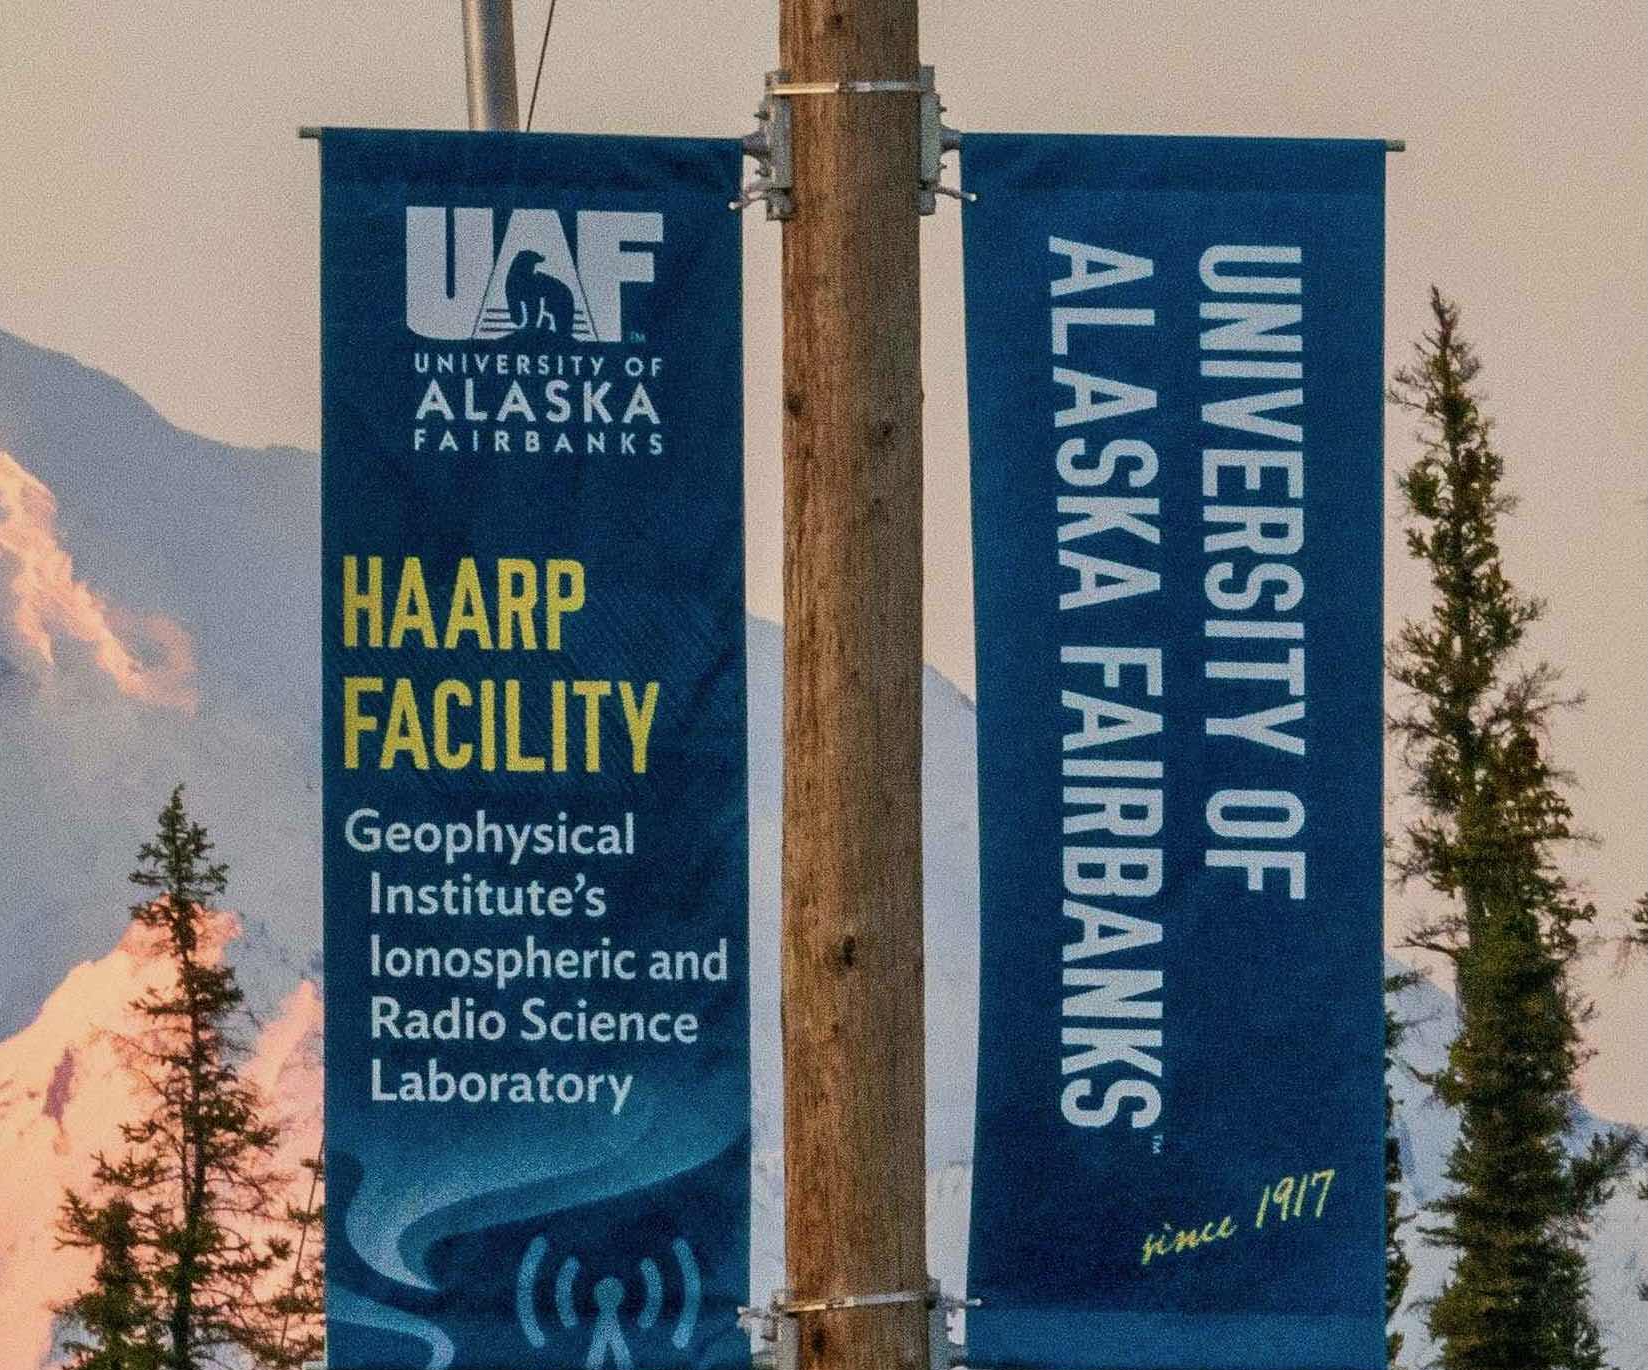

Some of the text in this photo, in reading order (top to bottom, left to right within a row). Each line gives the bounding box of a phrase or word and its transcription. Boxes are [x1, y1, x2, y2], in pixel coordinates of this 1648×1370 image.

[406, 206, 663, 342] UAF
[415, 353, 661, 377] UNIVERSITY OF
[417, 379, 659, 424] ALASKA
[414, 429, 662, 454] FAIRBANKS
[1199, 246, 1305, 899] UNIVERSITY OF
[344, 557, 585, 649] HAARP
[1049, 237, 1163, 1128] ALASKA FAIRBANKS
[345, 678, 659, 772] FACILITY
[346, 808, 633, 864] Geophysical
[371, 935, 727, 988] Ionospheric and
[372, 996, 698, 1043] Radio Science
[372, 1059, 632, 1114] Laboratory
[1143, 1169, 1334, 1264] since 1917
